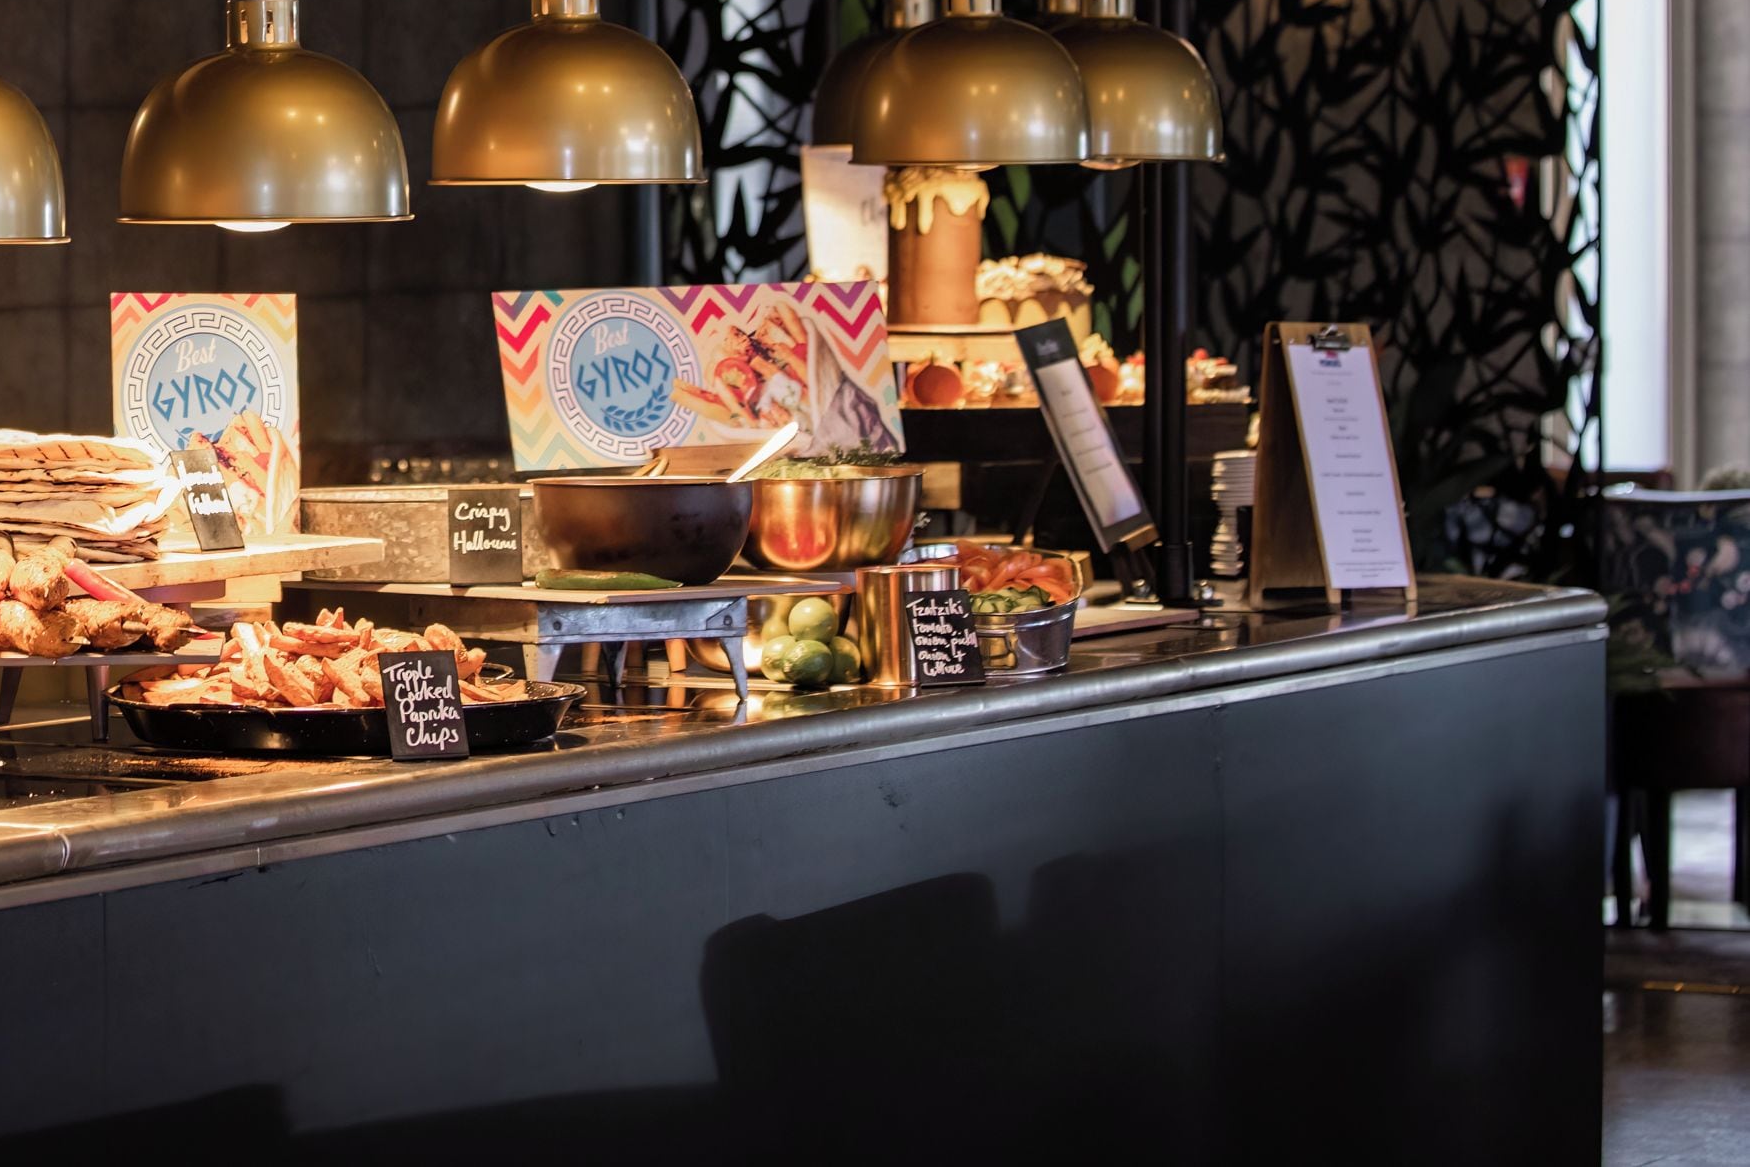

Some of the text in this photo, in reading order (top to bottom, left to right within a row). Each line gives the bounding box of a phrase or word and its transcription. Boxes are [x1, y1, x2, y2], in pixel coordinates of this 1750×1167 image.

[591, 321, 629, 355] Best
[175, 337, 217, 372] Best
[577, 343, 670, 401] GYROS
[152, 363, 256, 422] GYROS
[454, 502, 511, 531] Crispy
[453, 530, 517, 554] Halloumi
[395, 675, 455, 702] Cooked
[400, 699, 460, 723] Paprika
[406, 722, 459, 750] Chips
